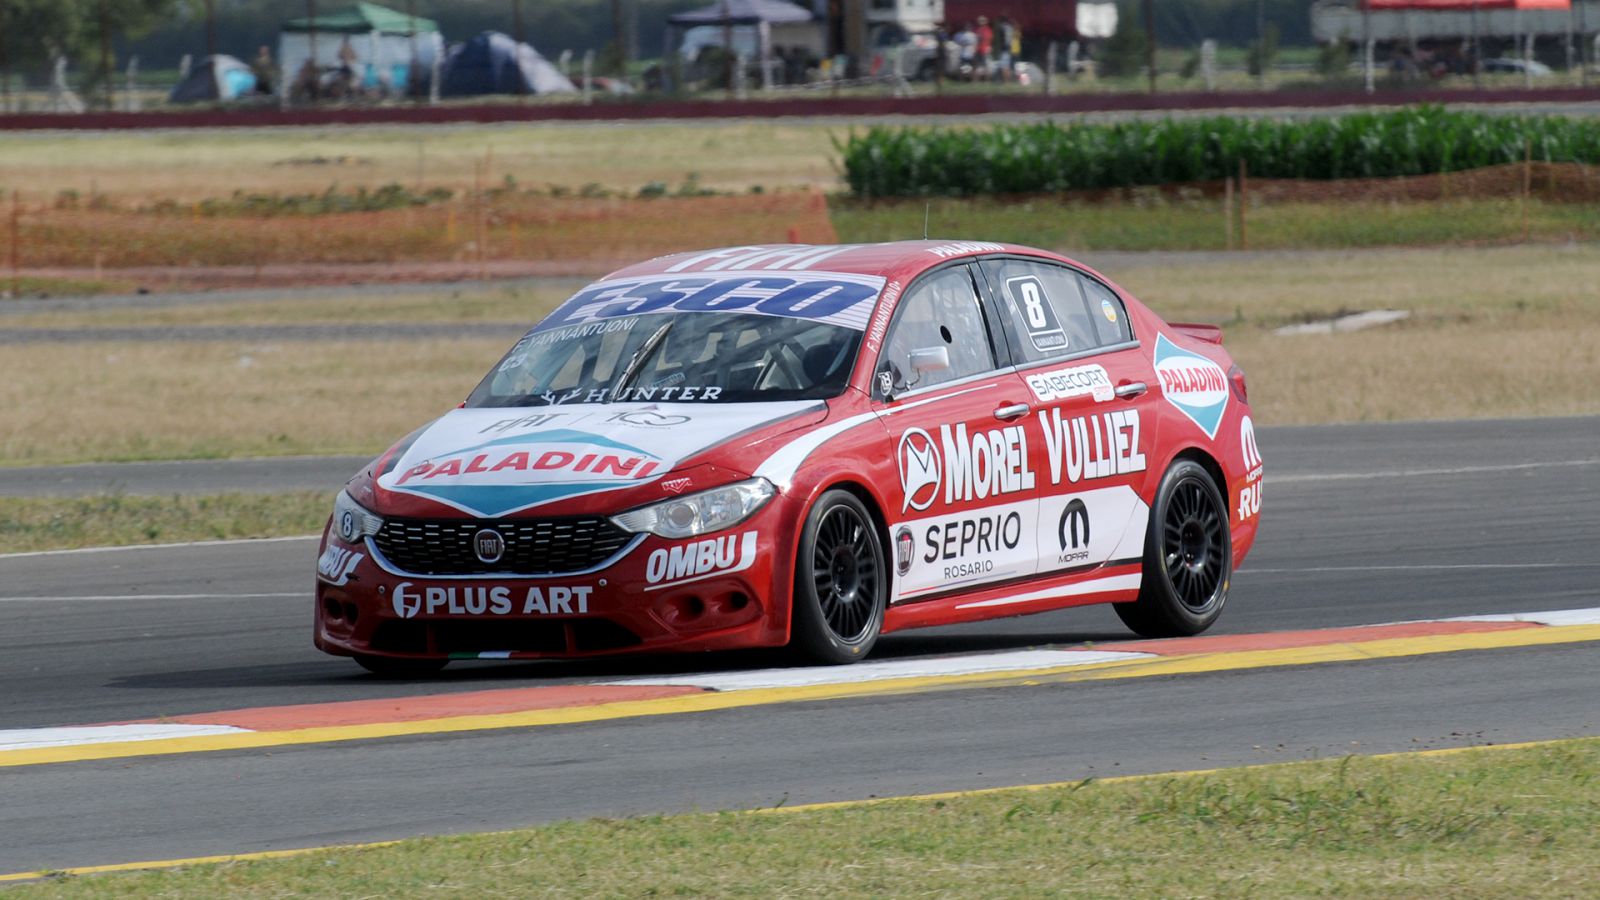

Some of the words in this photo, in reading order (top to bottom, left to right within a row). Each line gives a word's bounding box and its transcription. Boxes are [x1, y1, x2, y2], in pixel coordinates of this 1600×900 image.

[927, 243, 1005, 258] PALADINI
[528, 278, 878, 335] ESCO
[1021, 282, 1047, 329] 8
[528, 318, 640, 348] YANNANTUONI
[583, 386, 722, 402] HUNTER
[1031, 369, 1108, 395] SABECORT
[1159, 367, 1226, 393] PALADINI
[479, 413, 569, 434] FIAT
[395, 450, 660, 486] PALADINI
[940, 421, 1036, 505] MOREL
[1038, 407, 1147, 485] VULLIEZ
[343, 512, 353, 537] 8
[923, 511, 1021, 564] SEPRIO
[645, 535, 737, 584] OMBU
[943, 560, 994, 579] ROSARIO
[1058, 550, 1089, 564] MOPAR
[426, 586, 512, 615] PLUS
[522, 585, 593, 615] ART
